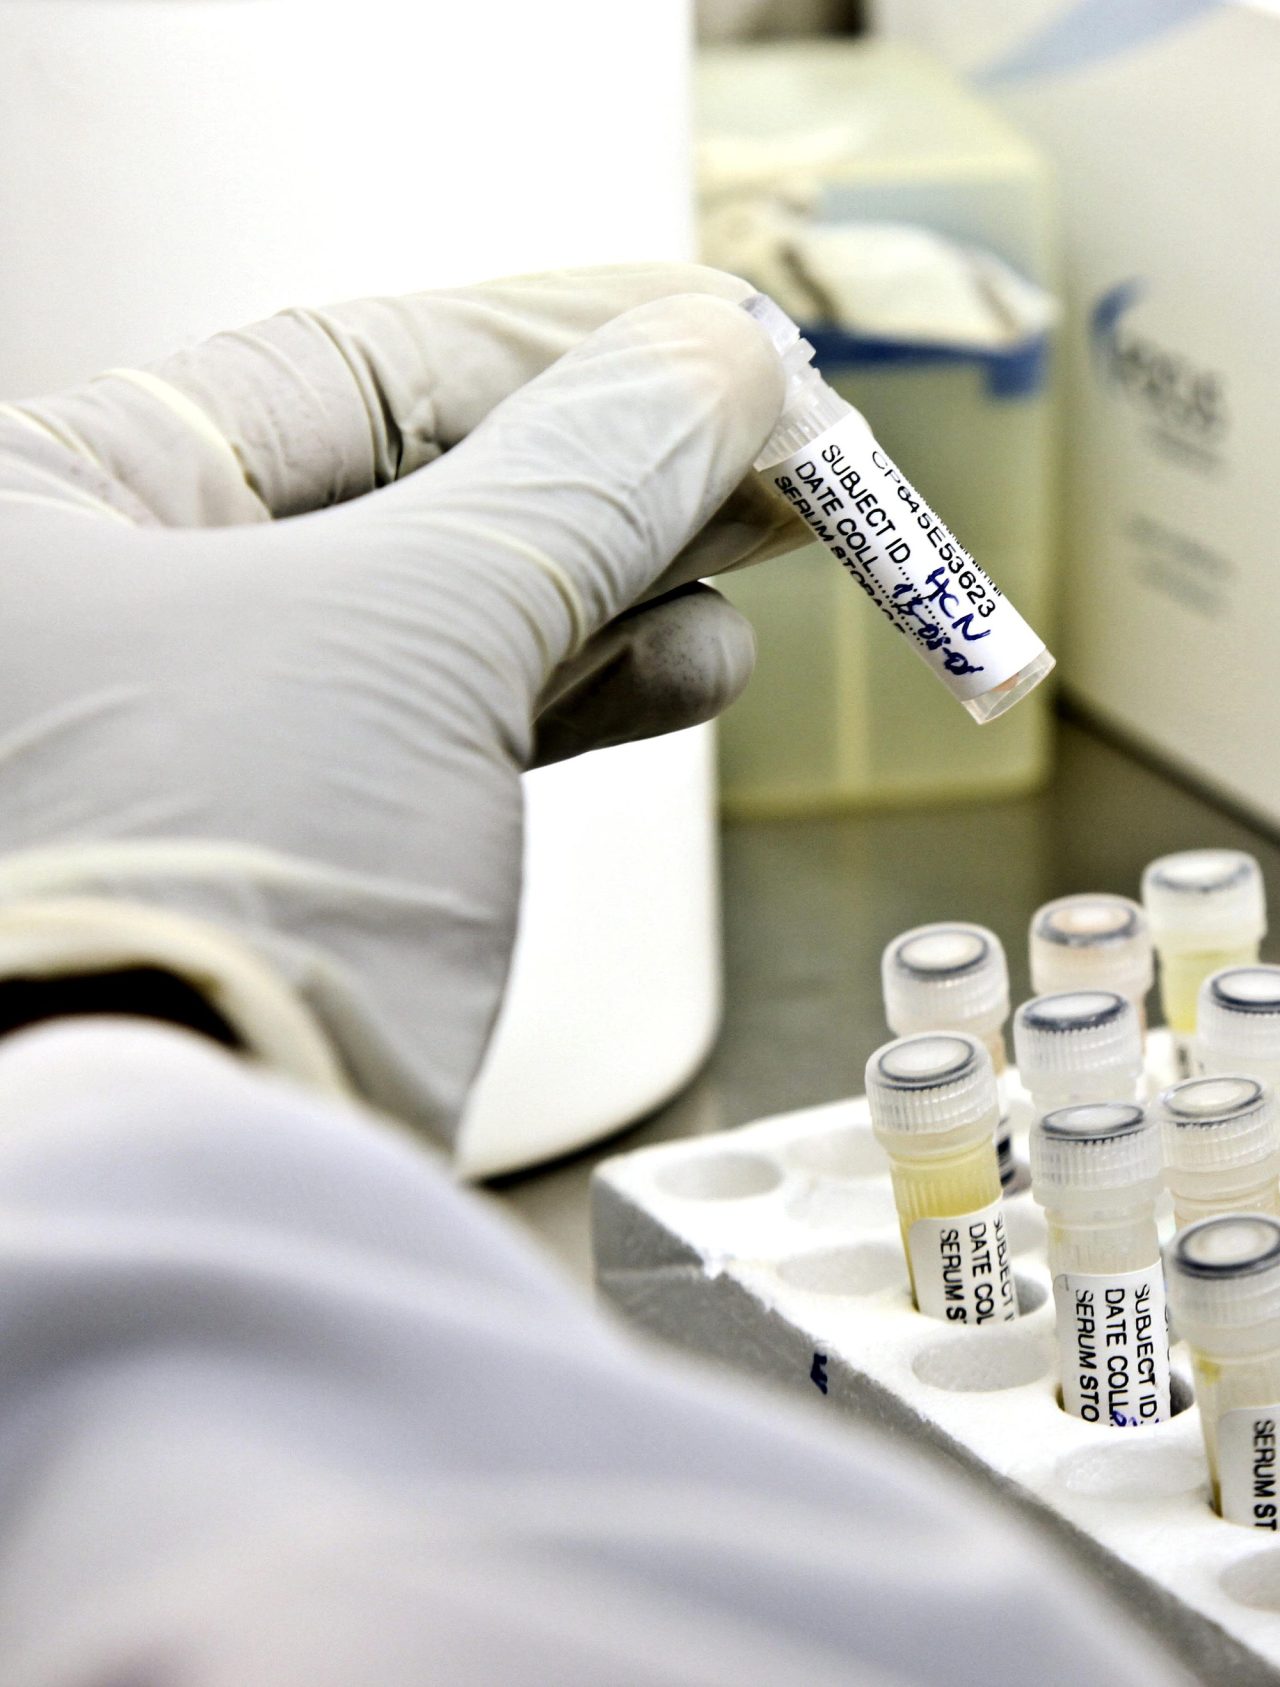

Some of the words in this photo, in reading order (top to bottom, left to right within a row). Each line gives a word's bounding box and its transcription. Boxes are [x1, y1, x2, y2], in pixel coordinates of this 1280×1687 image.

[795, 461, 844, 516] DATE
[821, 444, 896, 537] SUBJECT
[940, 1228, 965, 1301] SERUM
[969, 1222, 992, 1277] DATE
[1076, 1289, 1097, 1369] SERUM
[1105, 1288, 1127, 1347] DATE
[1135, 1283, 1156, 1386] SUBJECT
[1253, 1420, 1276, 1497] SERUM
